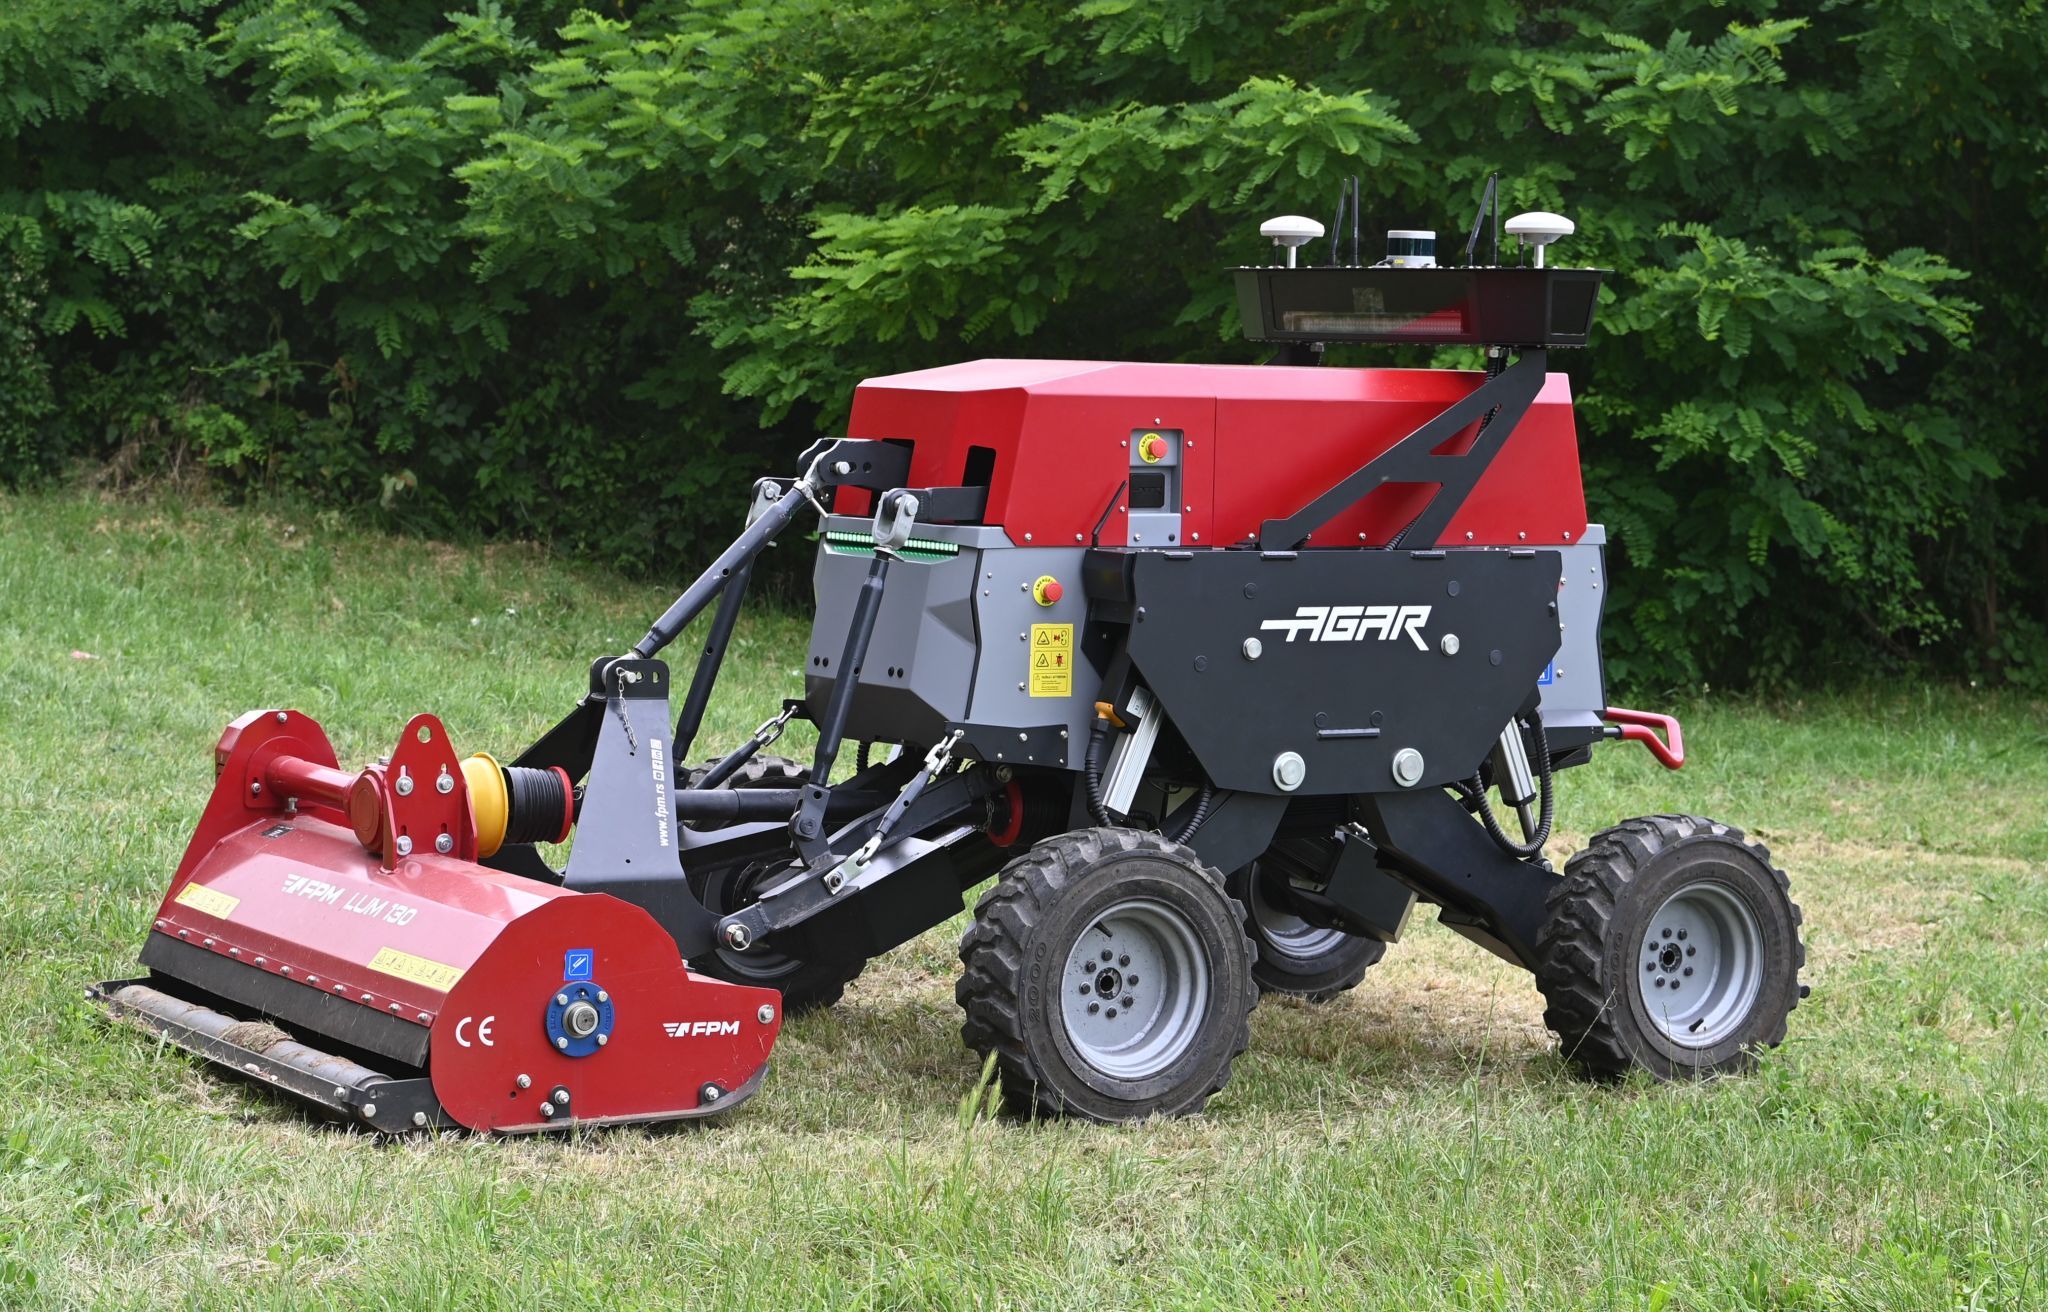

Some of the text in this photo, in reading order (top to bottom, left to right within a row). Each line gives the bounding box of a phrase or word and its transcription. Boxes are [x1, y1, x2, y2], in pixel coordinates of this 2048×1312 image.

[1260, 605, 1432, 651] AGAR
[655, 783, 669, 847] www.fpm.rs
[297, 879, 418, 926] FPM LUM 130
[455, 1015, 495, 1048] CE
[691, 1020, 740, 1037] FPM
